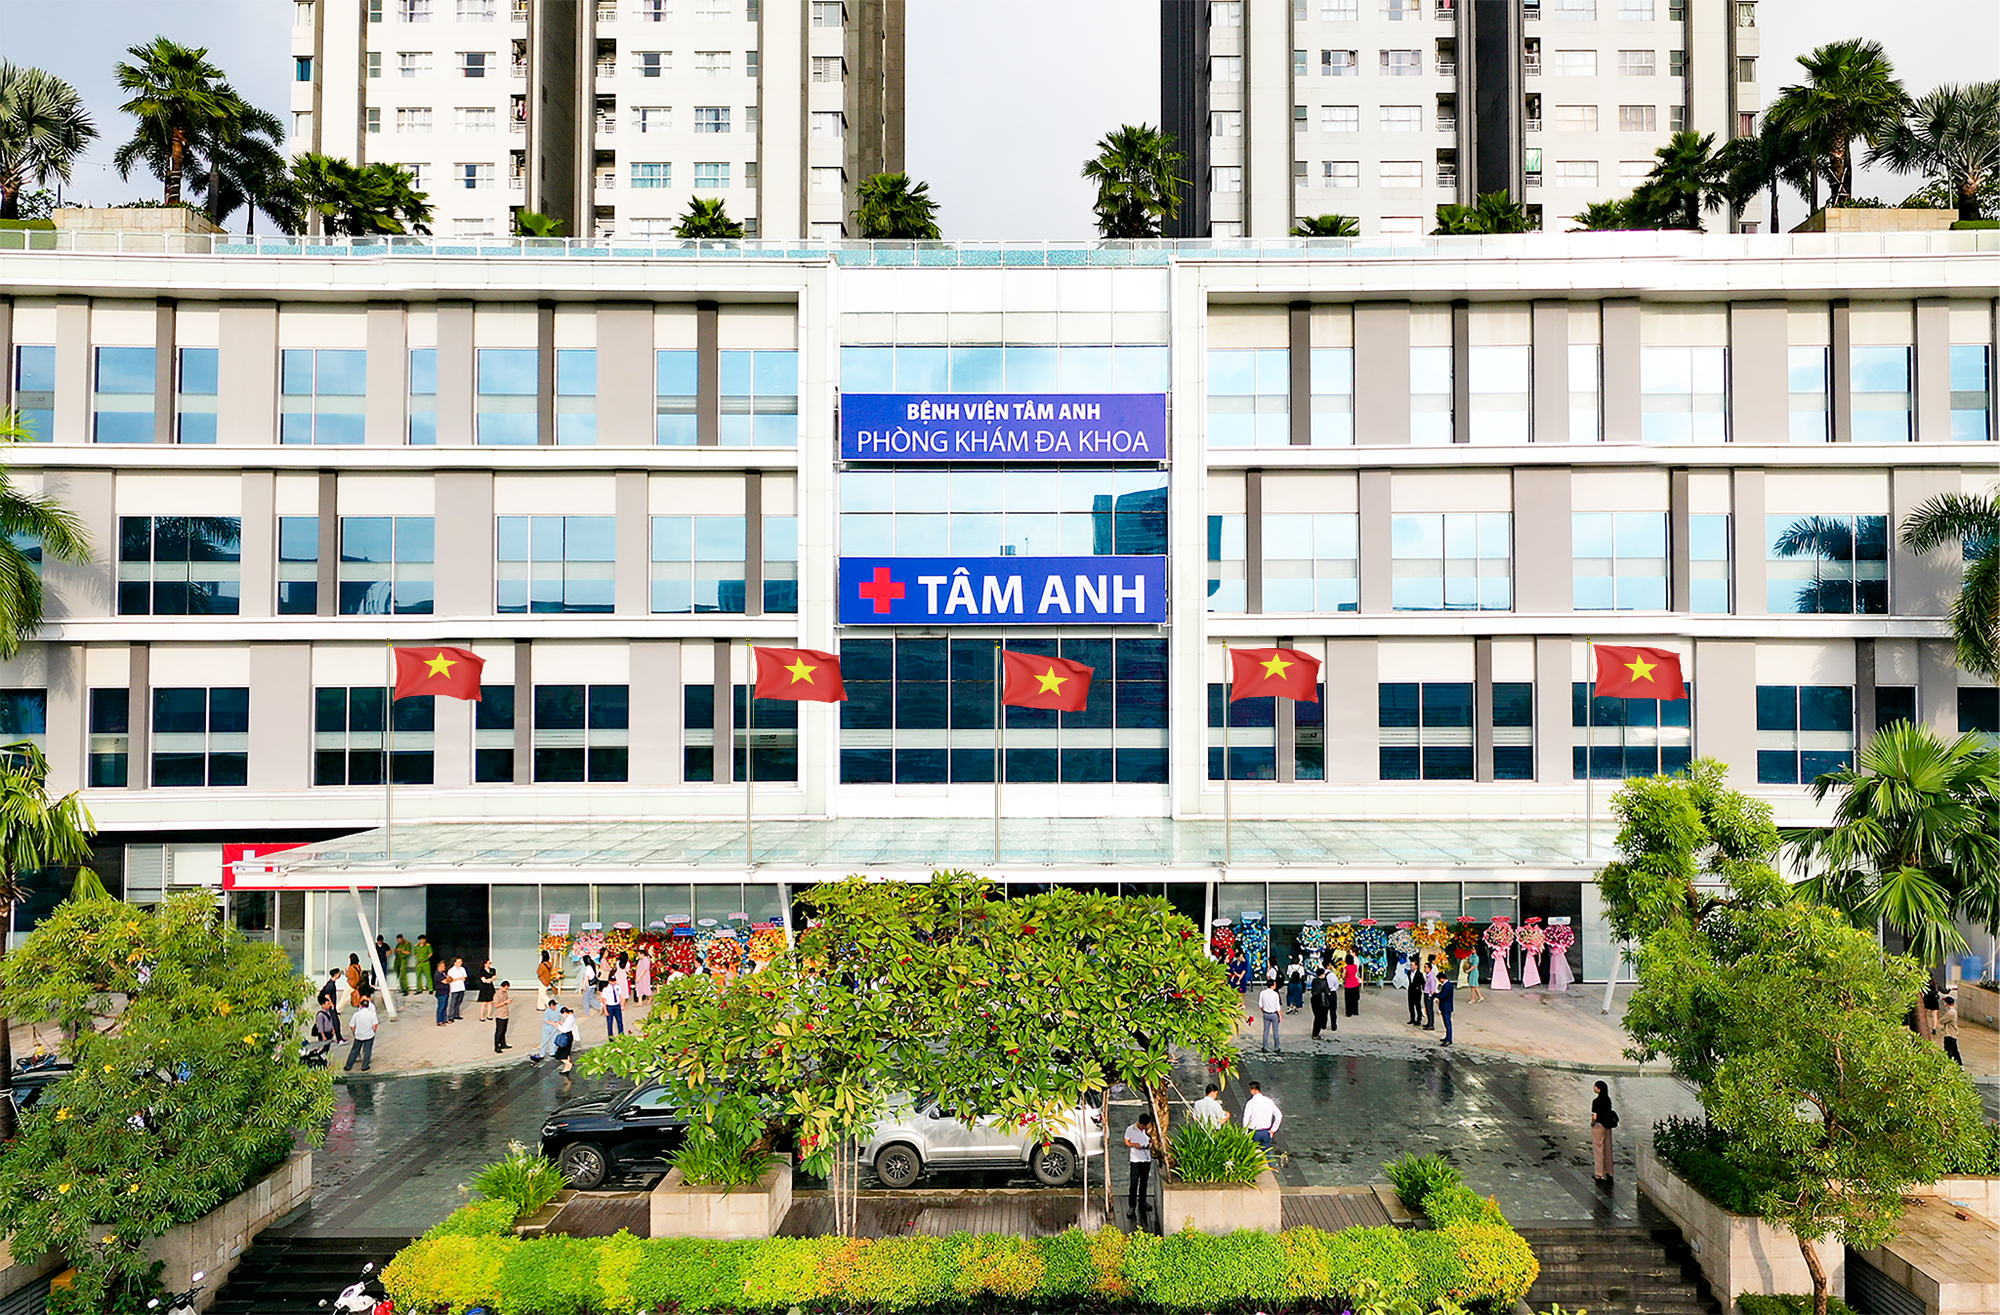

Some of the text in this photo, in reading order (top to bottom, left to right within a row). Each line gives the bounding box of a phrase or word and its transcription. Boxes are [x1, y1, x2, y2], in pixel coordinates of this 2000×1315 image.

[907, 399, 1101, 425] BỆNH VIỆN TÂM ANH
[858, 426, 1150, 453] PHÒNG KHÁM ĐA KHOA
[917, 566, 1145, 615] TÂM ANH
